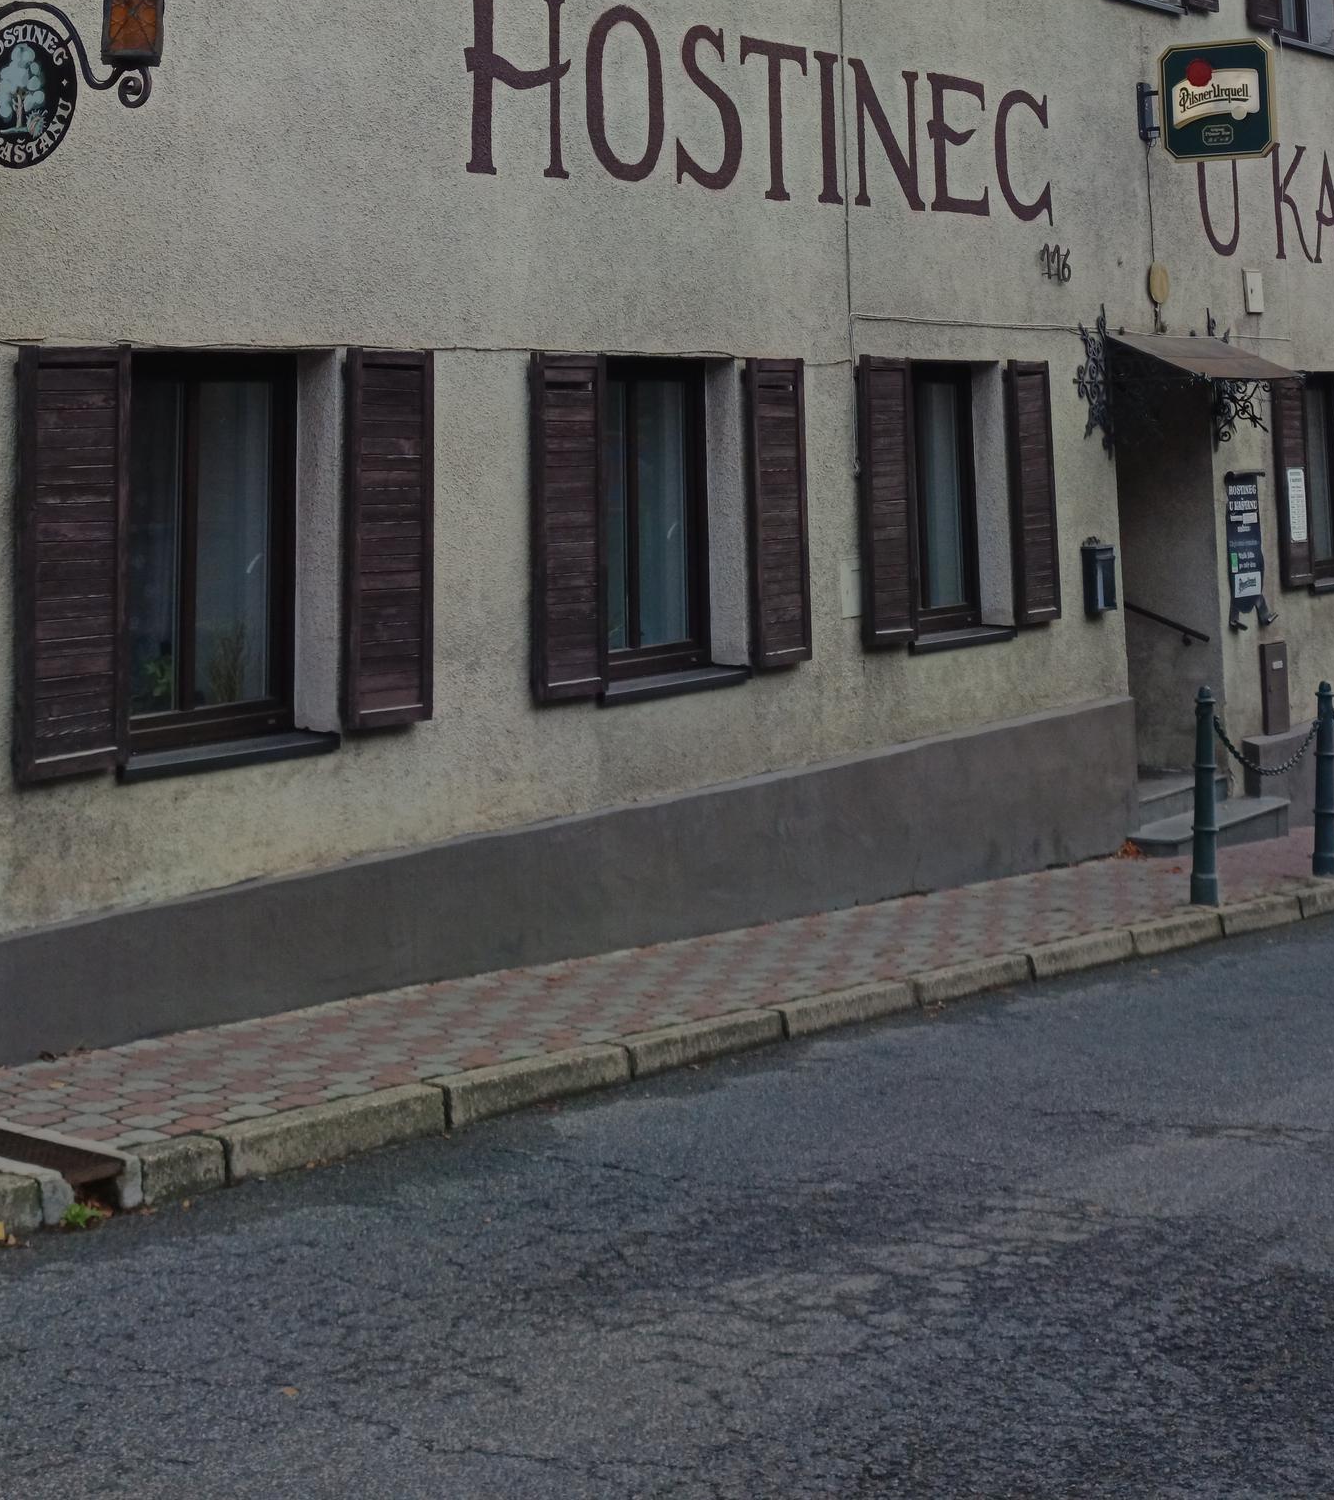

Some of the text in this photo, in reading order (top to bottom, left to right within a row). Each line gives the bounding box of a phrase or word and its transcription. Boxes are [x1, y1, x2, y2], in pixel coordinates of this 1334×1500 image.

[1178, 83, 1250, 113] Pilsner Urquell
[1197, 159, 1240, 256] U
[1040, 243, 1071, 283] 116
